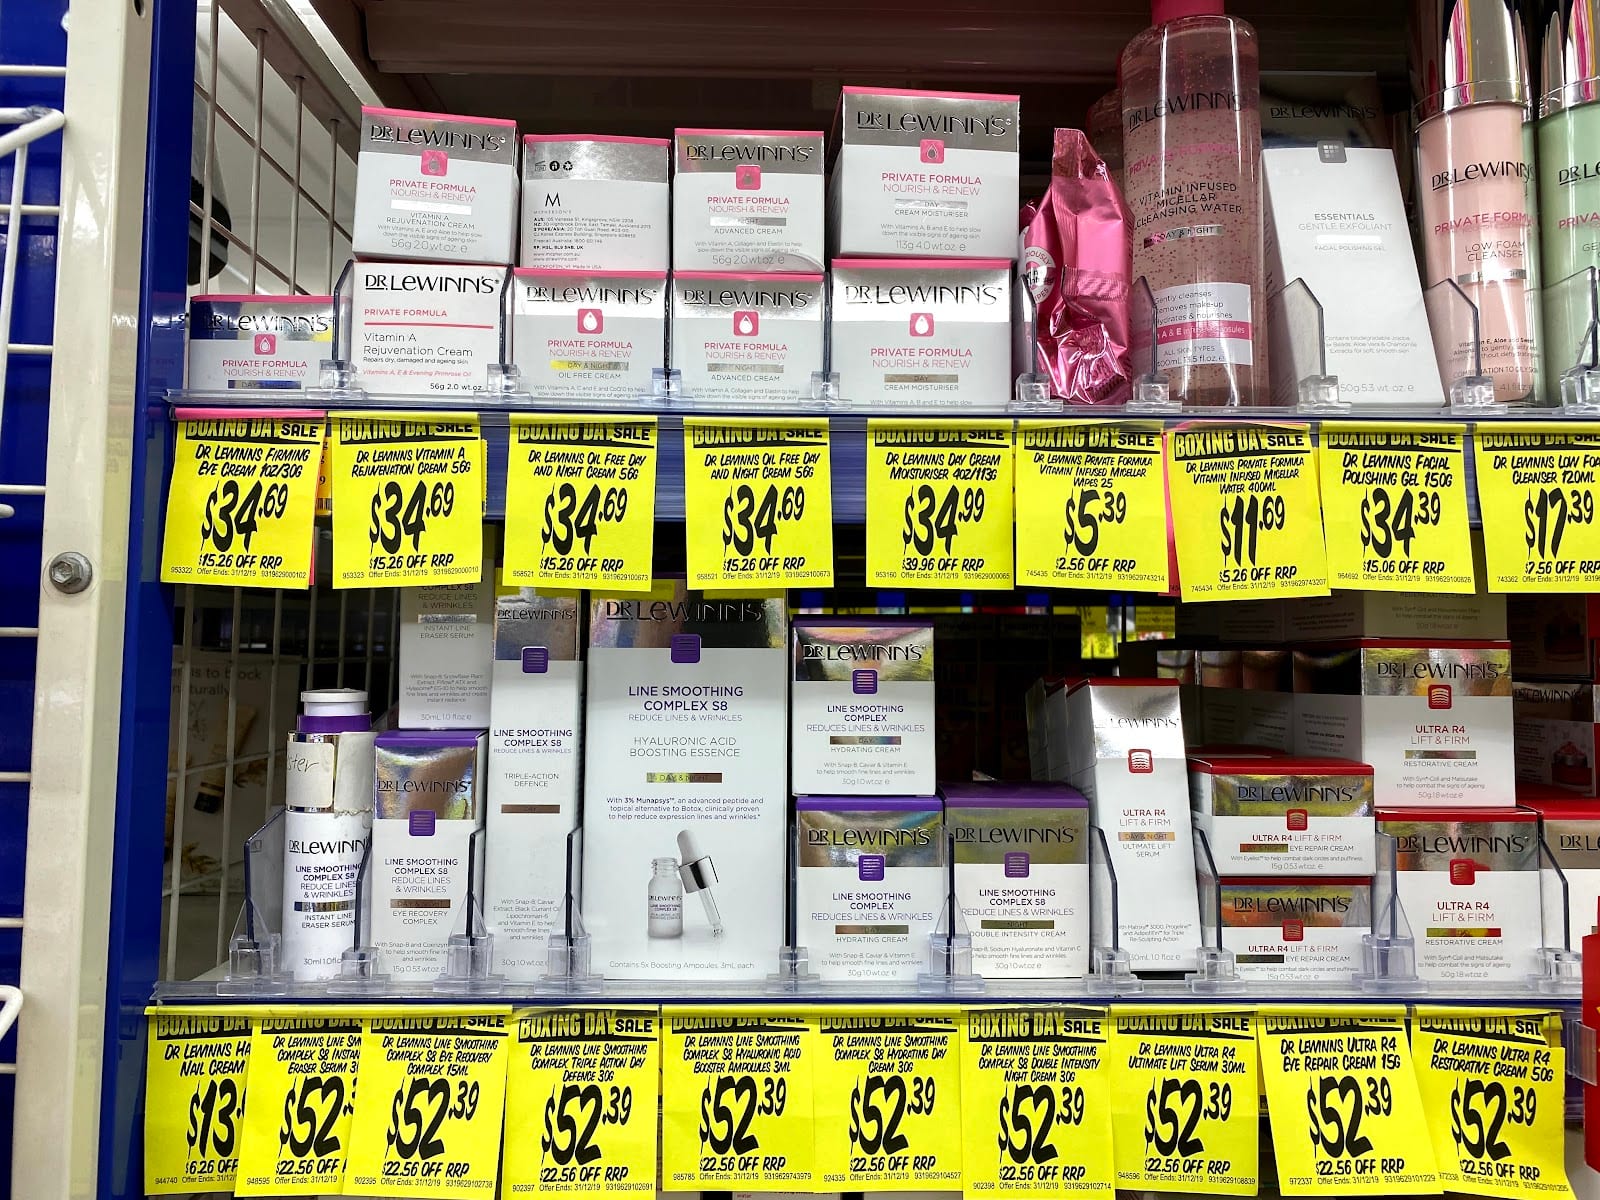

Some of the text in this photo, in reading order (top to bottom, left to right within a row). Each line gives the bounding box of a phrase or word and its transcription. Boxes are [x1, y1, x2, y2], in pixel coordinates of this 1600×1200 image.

[881, 173, 981, 185] PRIVATE FORMULA
[884, 184, 979, 195] NOURISH & RENEW
[1139, 182, 1237, 205] VITAMIN INFUSED
[1157, 193, 1216, 208] MICELLAR
[1200, 204, 1241, 215] WATER
[1314, 213, 1375, 221] ESSENTIALS
[1298, 222, 1392, 231] GENTLE EXFOLIANT
[1465, 242, 1492, 253] LOW
[364, 308, 447, 317] PRIVATE FORMULA
[364, 333, 416, 342] Vitamin A
[363, 345, 472, 358] Rejuvenation Cream
[430, 383, 445, 391] 56g
[196, 445, 310, 462] DR LEWINNS FIRMING
[416, 448, 464, 461] VITAMIN A
[587, 453, 646, 466] OIL FREE DAY
[199, 462, 219, 475] EYE
[221, 464, 257, 477] CREAM
[352, 462, 470, 477] REJUVENATION CREAM 56G
[890, 467, 949, 479] MOISTURISER
[1073, 478, 1113, 488] WIPES 25
[1342, 471, 1452, 487] POLISHING GEL 150G
[1220, 480, 1276, 494] WATER 400ML
[199, 554, 283, 569] $15.26 OFF RRP
[1362, 560, 1445, 574] $15.06 OFF RRP
[628, 686, 743, 697] LINE SMOOTHING
[643, 701, 727, 711] COMPLEX S8
[1416, 725, 1465, 733] ULTRA R4
[634, 737, 736, 746] HYALURONIC ACID
[1445, 736, 1470, 744] FIRM
[630, 749, 740, 757] BOOSTING ESSENCE
[721, 797, 748, 806] peptide
[970, 1012, 1101, 1038] BOXING DAY SALE
[439, 1050, 492, 1063] EYE RECOVERY
[736, 1049, 801, 1060] HYALURONIC ACID
[571, 1058, 645, 1068] TRIPLE ACTION DAY
[1031, 1058, 1100, 1069] DOUBLE INTENSITY
[1284, 1053, 1400, 1072] EYE REPAIR CREAM 15G
[180, 1061, 244, 1077] NAIL CREAM
[446, 1065, 468, 1076] 15ML
[1316, 1158, 1405, 1175] $22.56 OFF RRP
